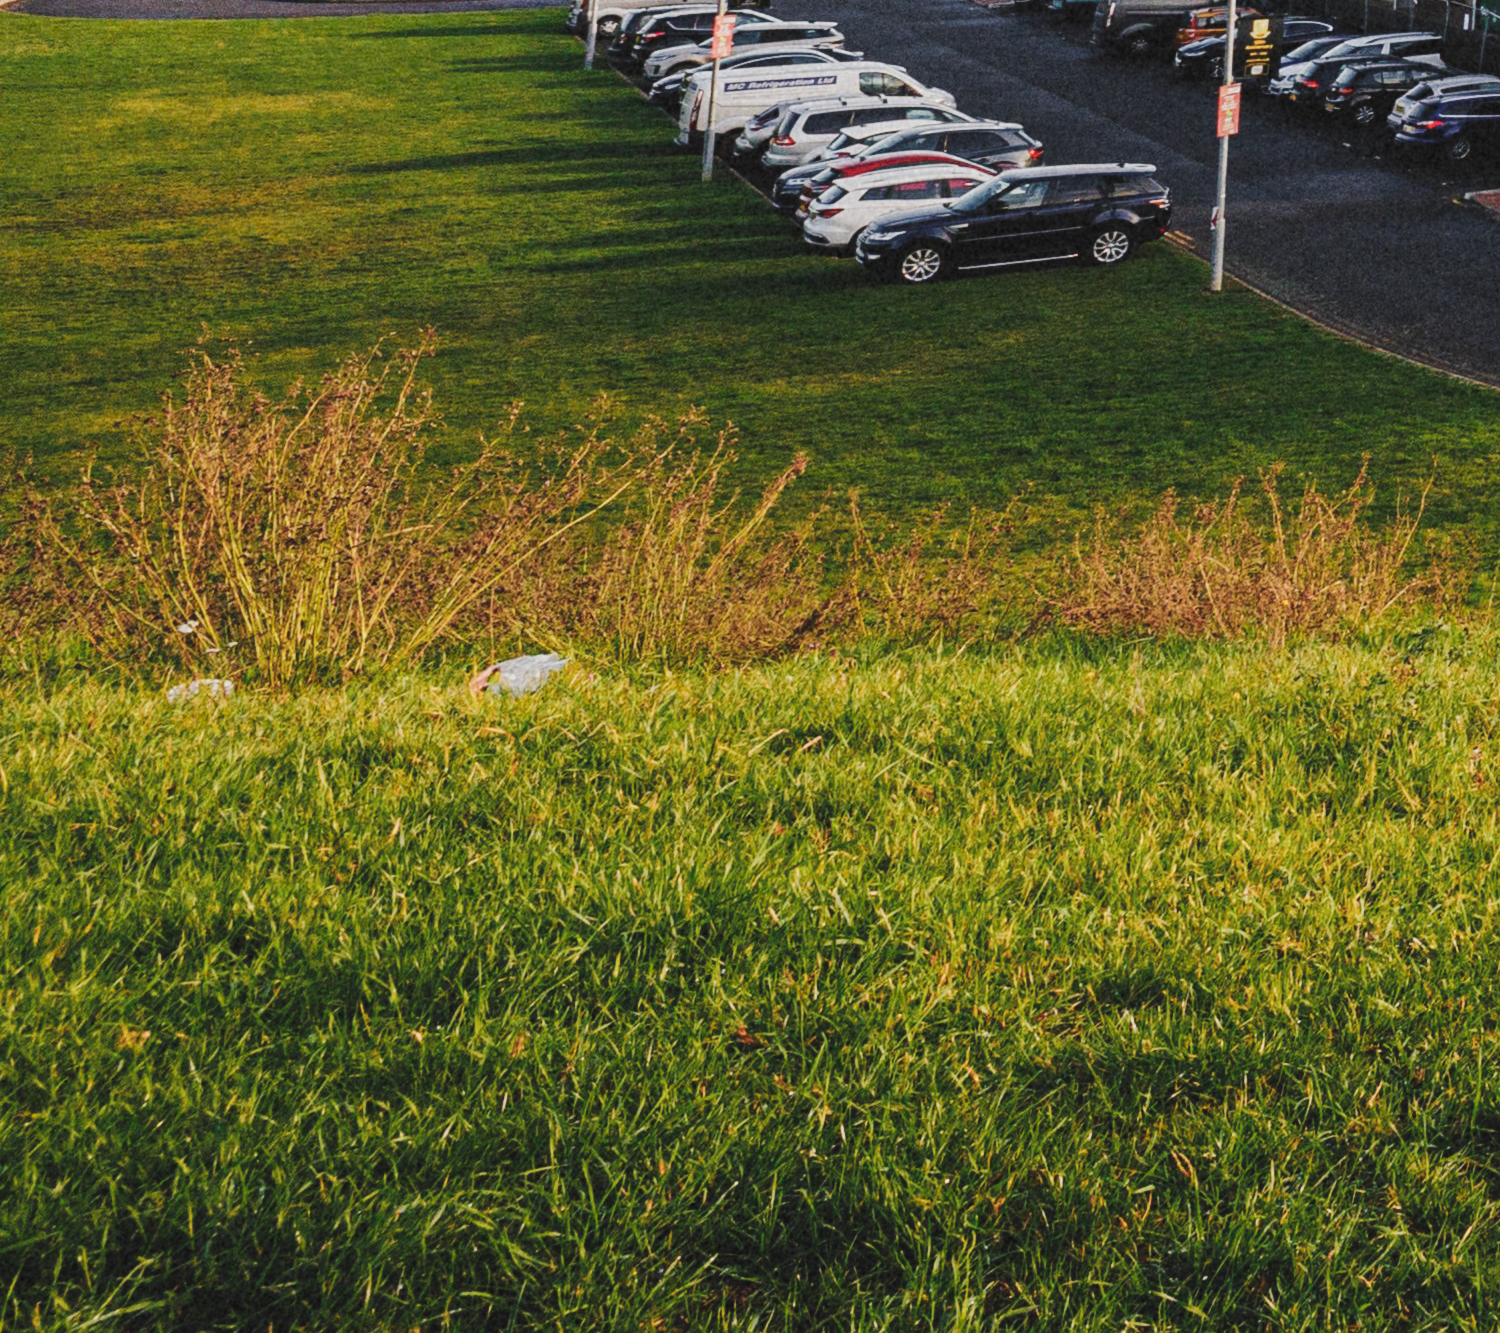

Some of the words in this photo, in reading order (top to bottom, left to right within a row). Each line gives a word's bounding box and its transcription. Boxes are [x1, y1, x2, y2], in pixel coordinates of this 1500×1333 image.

[726, 82, 745, 91] MC
[747, 78, 815, 90] Refrigeration
[817, 76, 835, 85] Ltd
